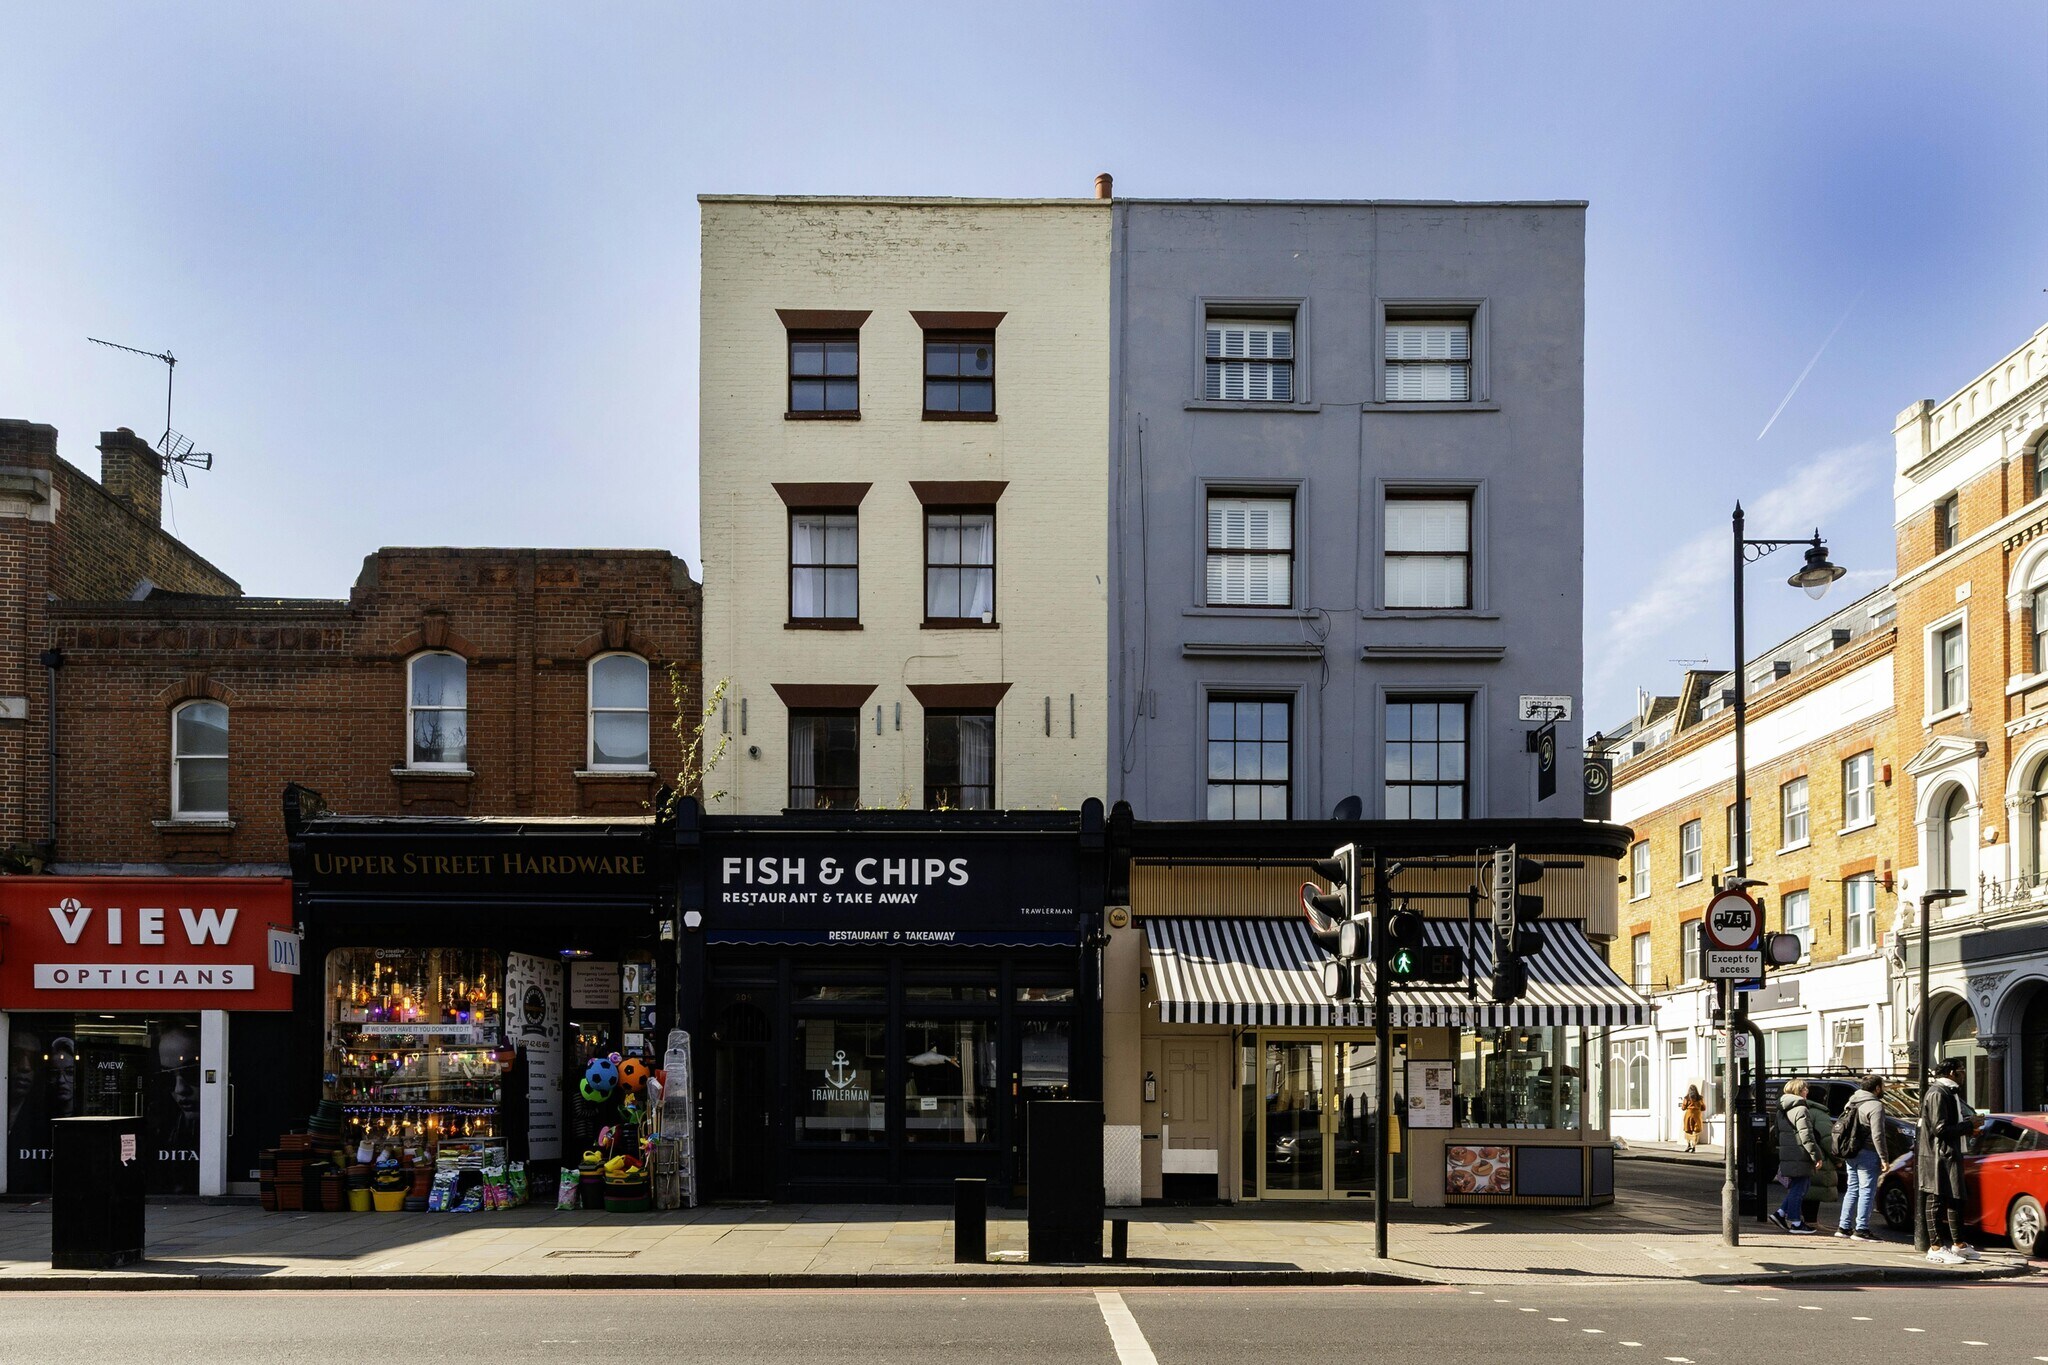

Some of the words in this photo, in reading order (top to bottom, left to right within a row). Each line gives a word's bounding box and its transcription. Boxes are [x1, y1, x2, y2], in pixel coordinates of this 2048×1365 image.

[314, 853, 397, 875] UPPER
[403, 853, 494, 875] STREET
[503, 853, 646, 875] HARDWARE
[722, 857, 805, 885] FISH
[818, 857, 844, 885] &
[855, 857, 969, 886] CHIPS
[722, 892, 818, 904] RESTAURANT
[823, 892, 832, 904] &
[836, 893, 872, 904] TAKE
[878, 893, 919, 904] AWAY
[48, 907, 239, 945] VIEW
[829, 931, 889, 941] RESTAURANT
[893, 931, 900, 940] &
[905, 931, 955, 941] TAKEAWAY
[274, 940, 298, 966] D.I.Y.
[1711, 954, 1743, 964] Except
[1745, 954, 1758, 963] for
[53, 969, 234, 985] OPTICIANS
[1330, 1012, 1397, 1024] PHILIPE
[1403, 1012, 1479, 1024] CONTICINI
[97, 1061, 124, 1070] AVIEW
[811, 1089, 870, 1101] TRAWLERMAN
[158, 1150, 200, 1161] DITA
